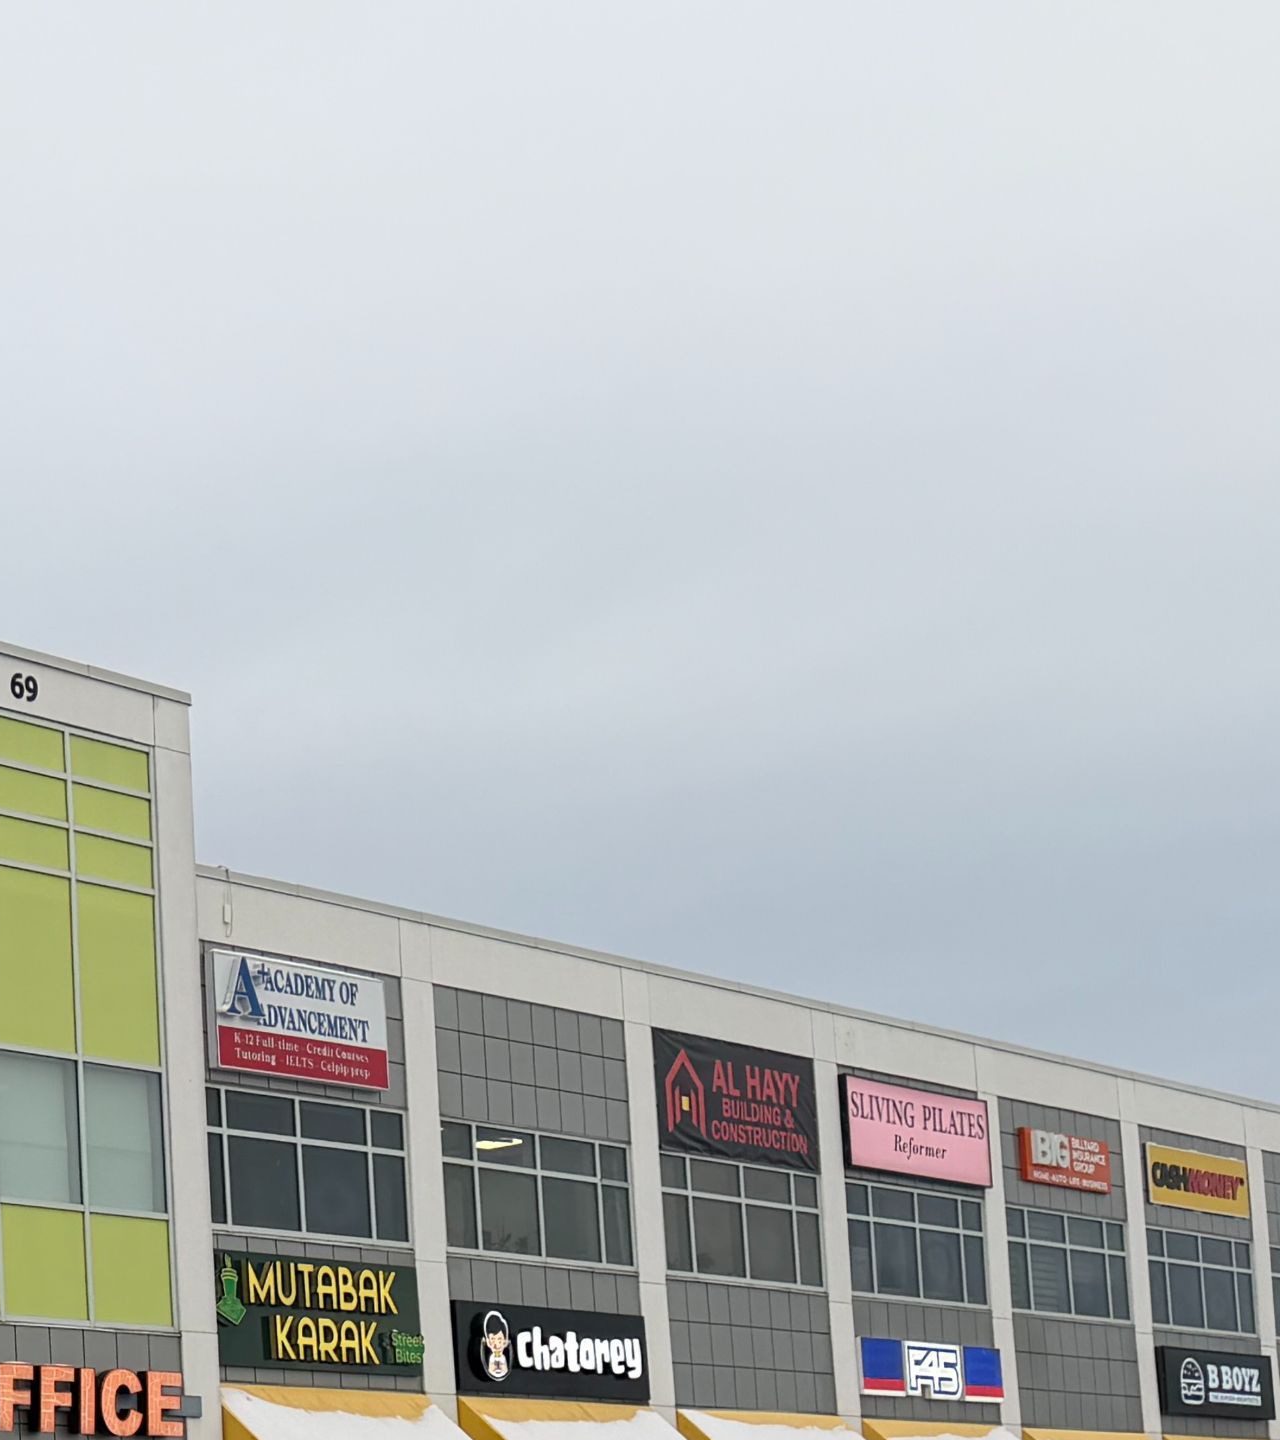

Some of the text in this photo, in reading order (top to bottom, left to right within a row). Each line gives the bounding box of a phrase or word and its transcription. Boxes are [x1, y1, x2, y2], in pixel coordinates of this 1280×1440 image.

[10, 672, 39, 703] 69
[263, 967, 359, 1007] ACADEMY OF
[256, 1003, 370, 1043] ADVANCEMENT
[234, 1047, 277, 1066] Tutoring
[285, 1055, 315, 1069] IELTS
[711, 1059, 801, 1108] AL HAYY
[721, 1097, 795, 1129] BUILDING &
[850, 1090, 986, 1141] SLIVING PILATES
[711, 1121, 809, 1154] CONSTRUCTION
[893, 1132, 948, 1160] Reformer
[1030, 1128, 1071, 1169] BIG
[1071, 1149, 1106, 1167] INSURANCE
[1072, 1161, 1096, 1175] GROUP
[246, 1260, 399, 1315] MUTABAK
[275, 1314, 381, 1366] KARAK
[391, 1331, 424, 1348] Street
[396, 1348, 422, 1364] Bites
[516, 1325, 643, 1380] Chatorey
[907, 1345, 961, 1396] F45
[1206, 1363, 1261, 1393] B BOYZ
